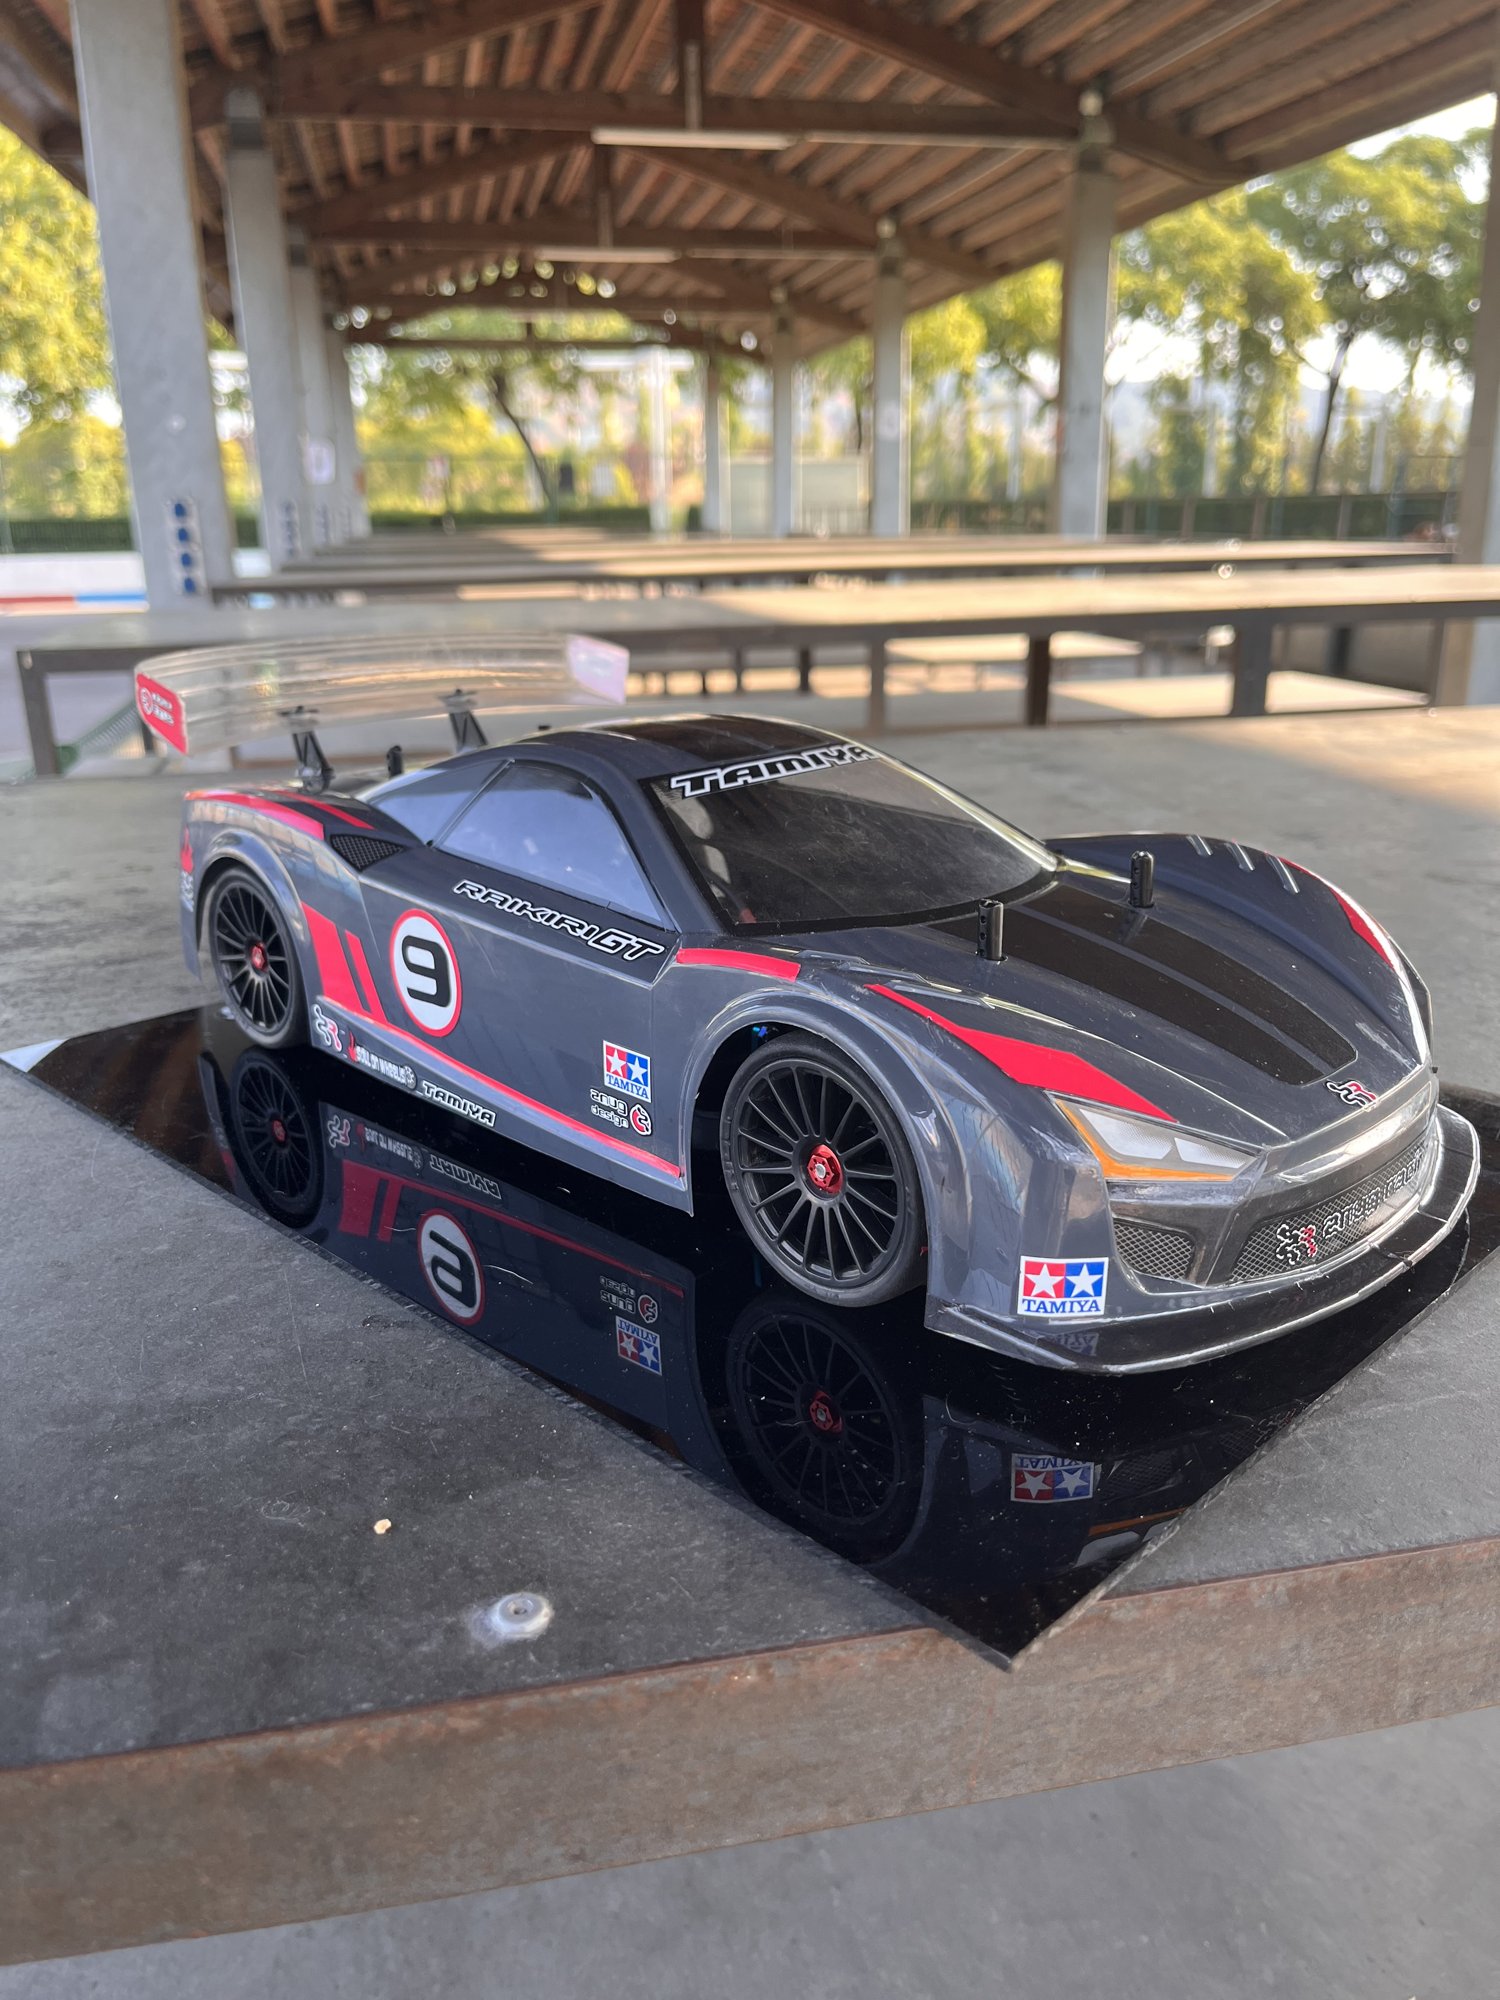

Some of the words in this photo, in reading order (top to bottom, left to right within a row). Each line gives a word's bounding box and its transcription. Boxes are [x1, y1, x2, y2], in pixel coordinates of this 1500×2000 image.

[670, 744, 879, 797] TAMIYA
[453, 879, 601, 941] RAIKIRI
[587, 927, 665, 961] GT
[402, 935, 451, 1008] 9
[422, 1080, 497, 1127] TAMIYA
[606, 1074, 649, 1099] TAMIYA
[590, 1104, 629, 1128] design
[1021, 1298, 1101, 1314] TAMIYA
